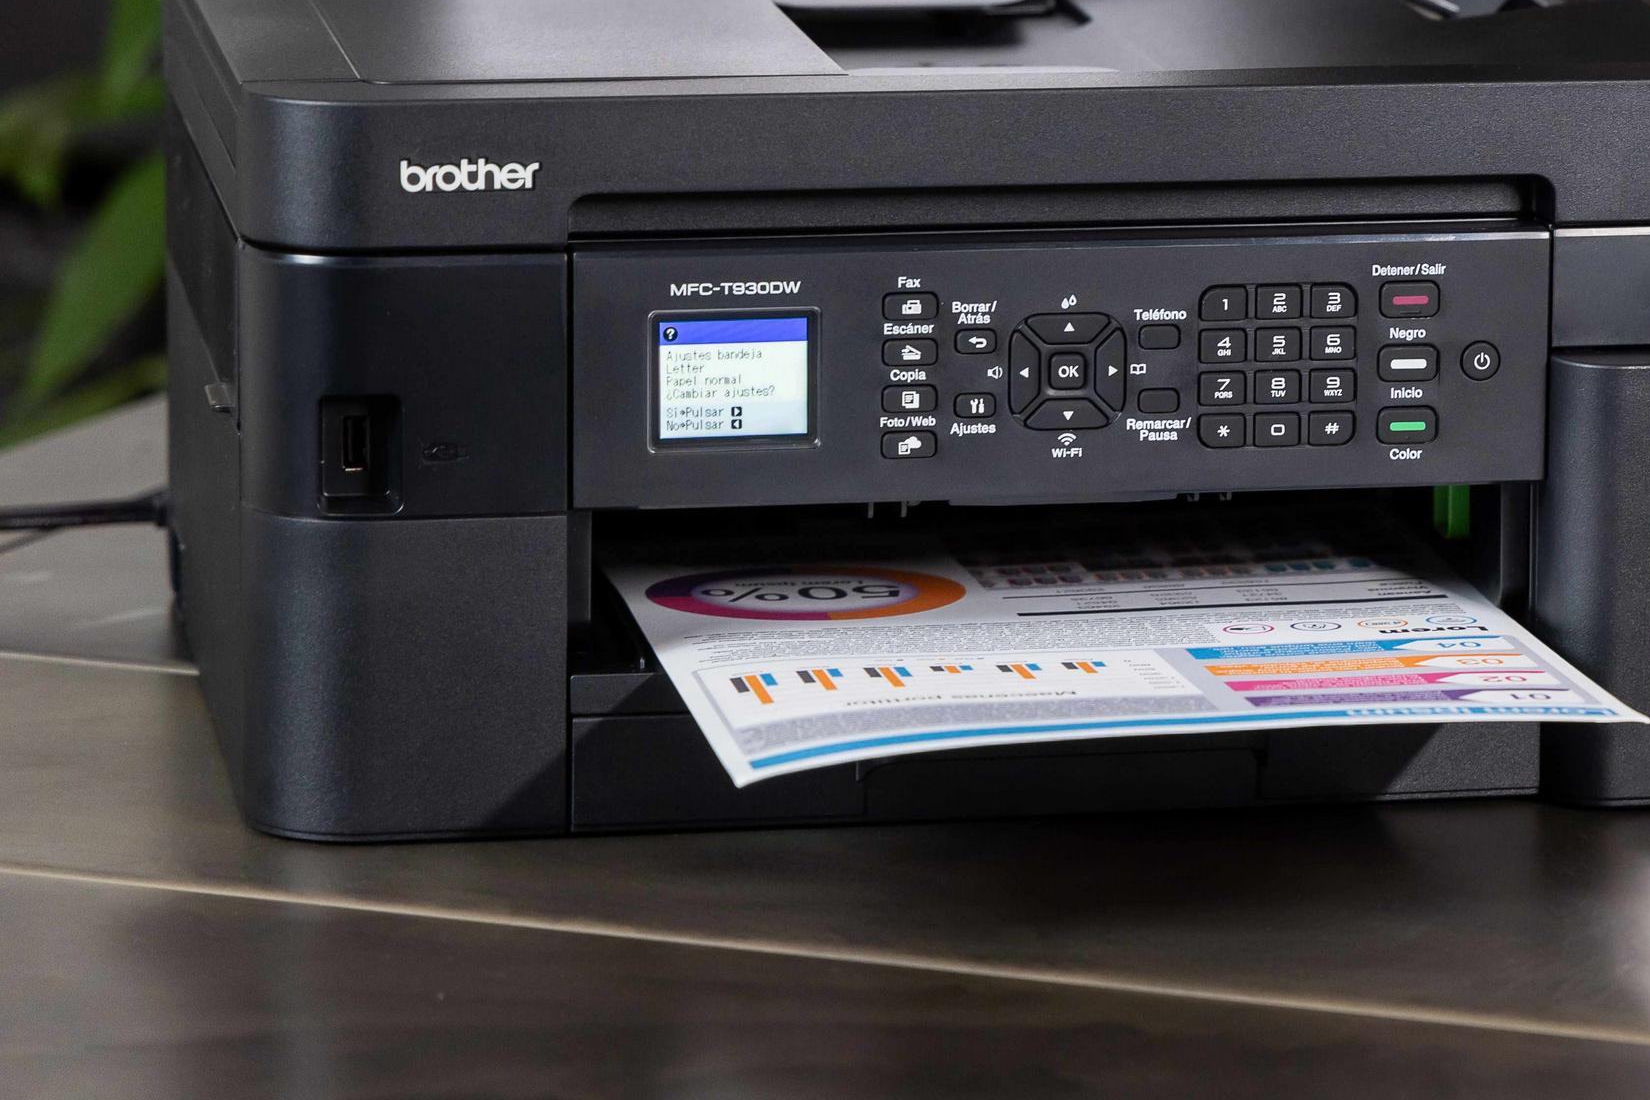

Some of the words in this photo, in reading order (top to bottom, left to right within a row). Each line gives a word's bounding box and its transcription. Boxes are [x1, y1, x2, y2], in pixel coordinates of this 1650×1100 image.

[400, 158, 540, 193] brother
[1372, 263, 1446, 276] Detener/Salir
[897, 276, 921, 288] Fax
[670, 281, 801, 297] MFC-T930DW
[1222, 298, 1228, 310] 1
[1273, 293, 1286, 305] 2
[1327, 292, 1341, 304] 3
[952, 300, 997, 314] Borrar/
[1272, 305, 1287, 313] ABC
[1326, 304, 1342, 312] DEF
[957, 311, 991, 325] Atrás
[1134, 308, 1187, 322] Teléfono
[883, 322, 934, 335] Escáner
[1389, 327, 1426, 340] Negro
[1217, 336, 1231, 348] 4
[1273, 335, 1286, 347] 5
[1326, 334, 1341, 346] 6
[666, 351, 711, 362] Ajustes
[717, 349, 762, 360] bandeja
[666, 363, 704, 374] Letter
[1058, 365, 1079, 378] OK
[666, 375, 697, 387] Papel
[705, 374, 742, 385] normal
[889, 369, 926, 382] Copia
[1217, 378, 1231, 390] 7
[1271, 377, 1286, 389] 8
[1326, 376, 1341, 389] 9
[666, 387, 717, 400] ¿Cambiar
[724, 385, 775, 398] ajustes?
[1323, 389, 1343, 397] WXYZ
[1390, 387, 1423, 400] Inicio
[880, 416, 936, 428] Foto/Web
[1126, 417, 1191, 431] Remarcar/
[1324, 422, 1340, 435] #
[950, 422, 996, 436] Ajustes
[1139, 429, 1178, 442] Pausa
[1271, 423, 1286, 436] 0
[1051, 447, 1082, 458] Wi-Fi
[1389, 448, 1423, 460] Color
[701, 584, 900, 602] 50%
[1378, 626, 1489, 635] Lorem
[1437, 641, 1481, 649] 04
[1483, 675, 1528, 683] 02
